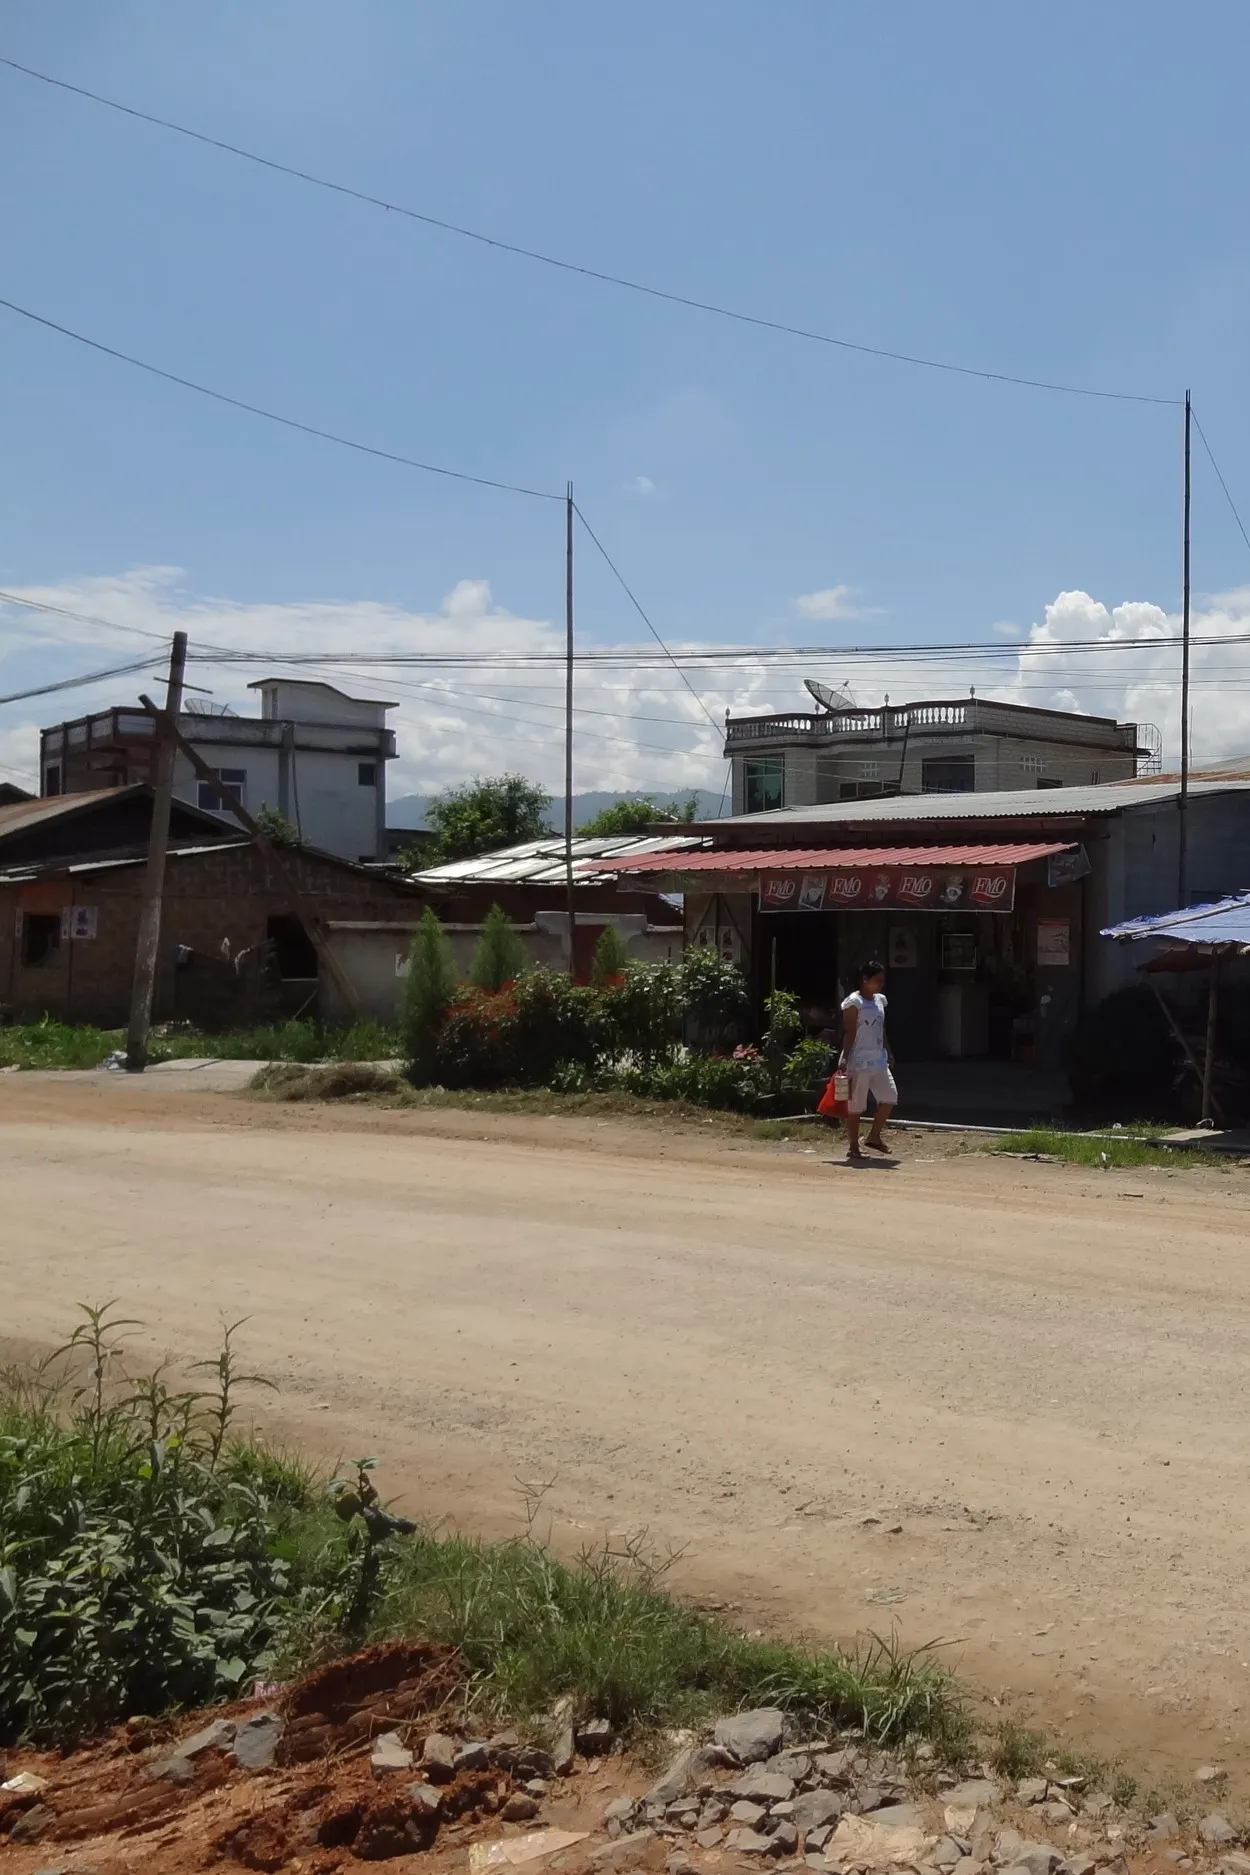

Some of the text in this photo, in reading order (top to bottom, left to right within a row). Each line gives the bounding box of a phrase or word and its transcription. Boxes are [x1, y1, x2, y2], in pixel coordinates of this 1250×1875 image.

[767, 879, 796, 899] EMO
[831, 876, 862, 898] EMO
[901, 875, 933, 898] EMO
[974, 877, 1007, 899] EMO
